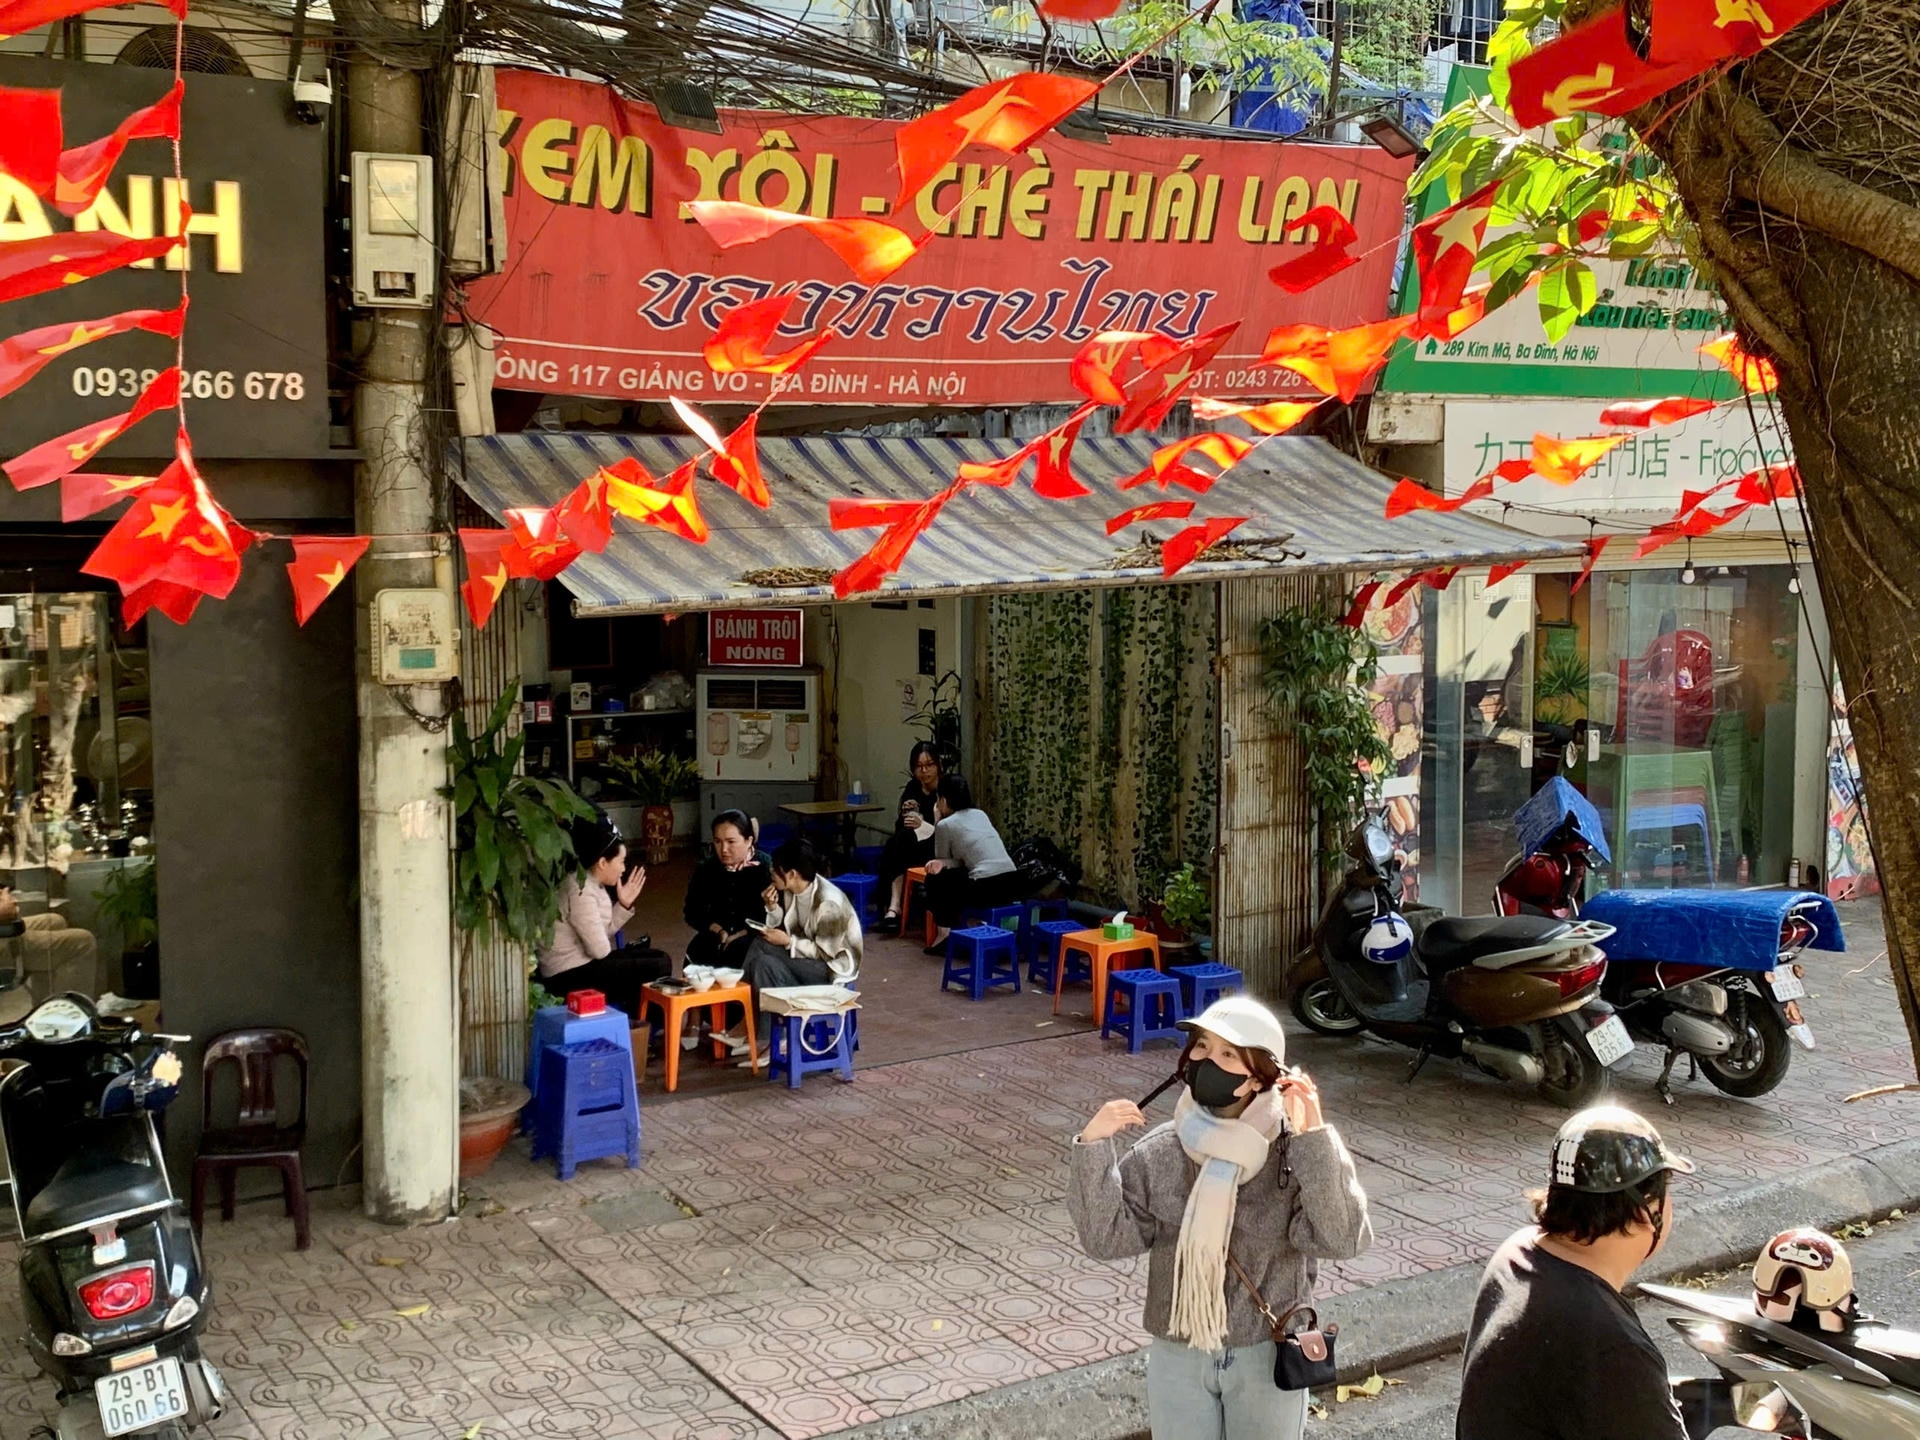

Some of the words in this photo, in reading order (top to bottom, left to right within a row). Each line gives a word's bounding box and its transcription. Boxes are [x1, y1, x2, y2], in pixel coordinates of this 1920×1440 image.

[678, 129, 836, 220] XÔI
[916, 147, 1052, 238] CHÈ
[1074, 154, 1221, 241] THÁI
[1238, 175, 1359, 243] LAN
[1442, 340, 1465, 357] 289
[1467, 341, 1488, 357] Kim
[1515, 344, 1530, 359] Ba
[1562, 345, 1579, 360] Hà
[1580, 345, 1600, 364] Nội
[244, 371, 305, 400] 678
[568, 364, 611, 387] 117
[618, 361, 704, 392] GIẢNG
[810, 368, 868, 394] ĐÌNH
[888, 369, 920, 395] HÀ
[926, 371, 967, 400] NỘI
[1225, 370, 1267, 388] 0243
[1272, 369, 1300, 387] 726
[715, 614, 758, 639] BÁNH
[762, 615, 797, 640] TRÔI
[726, 643, 785, 660] NÓNG
[108, 1364, 167, 1403] 29-B1
[108, 1389, 181, 1431] 060.66
